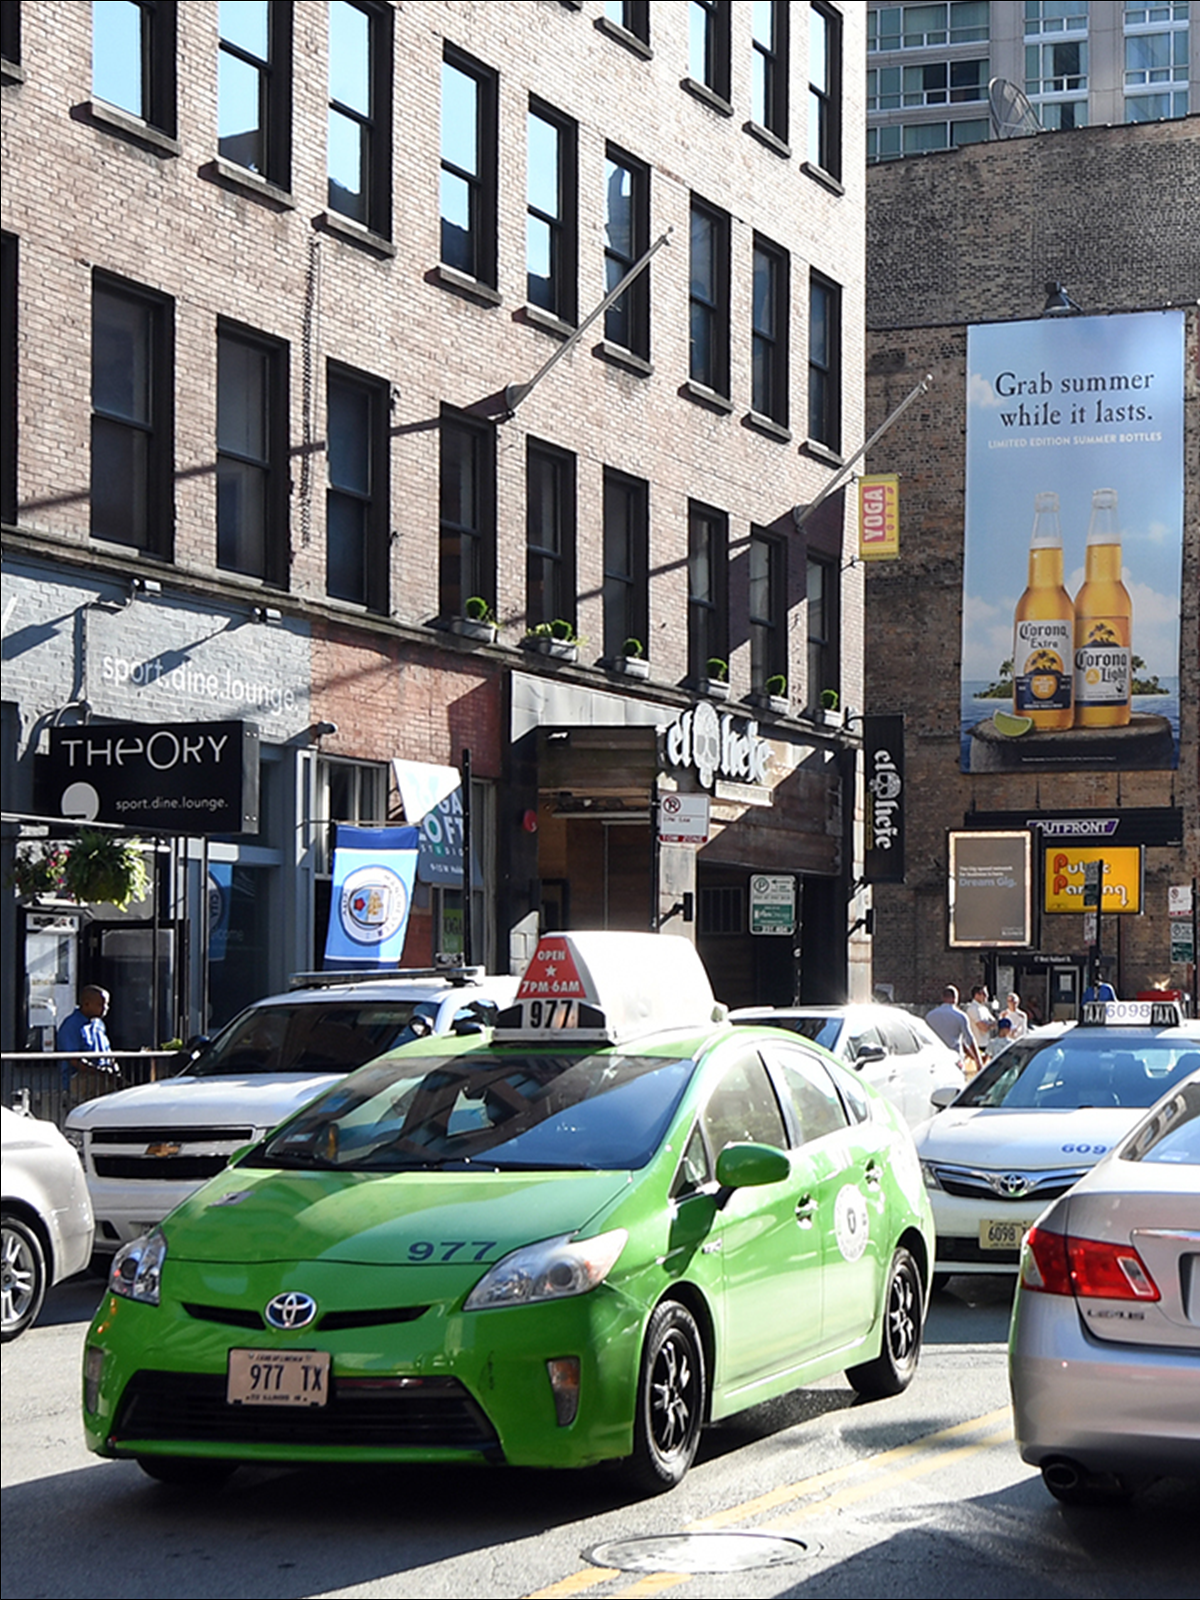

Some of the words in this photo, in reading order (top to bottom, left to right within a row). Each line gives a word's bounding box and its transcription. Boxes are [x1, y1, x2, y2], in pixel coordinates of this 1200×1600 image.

[995, 371, 1053, 398] Grab
[1060, 373, 1155, 395] summer
[1000, 402, 1062, 427] while
[1070, 402, 1087, 424] it
[1095, 399, 1153, 423] lasts.
[988, 437, 1028, 449] LIMITED
[1029, 436, 1071, 447] EDITION
[1073, 433, 1117, 445] SUMMER
[1119, 431, 1163, 442] BOTTLES
[864, 486, 884, 541] YOGA
[1019, 622, 1069, 640] Corona
[1075, 650, 1128, 672] Corona
[1053, 874, 1129, 907] Parng
[537, 950, 566, 961] OPEN
[530, 999, 574, 1029] 977
[1083, 1004, 1106, 1023] TAXI
[1106, 1003, 1150, 1018] 6098
[1153, 1005, 1177, 1024] TAXI
[1061, 1143, 1112, 1155] 609
[988, 1226, 1016, 1242] 6098
[407, 1241, 498, 1262] 977
[250, 1364, 285, 1391] 977
[301, 1365, 322, 1391] TX
